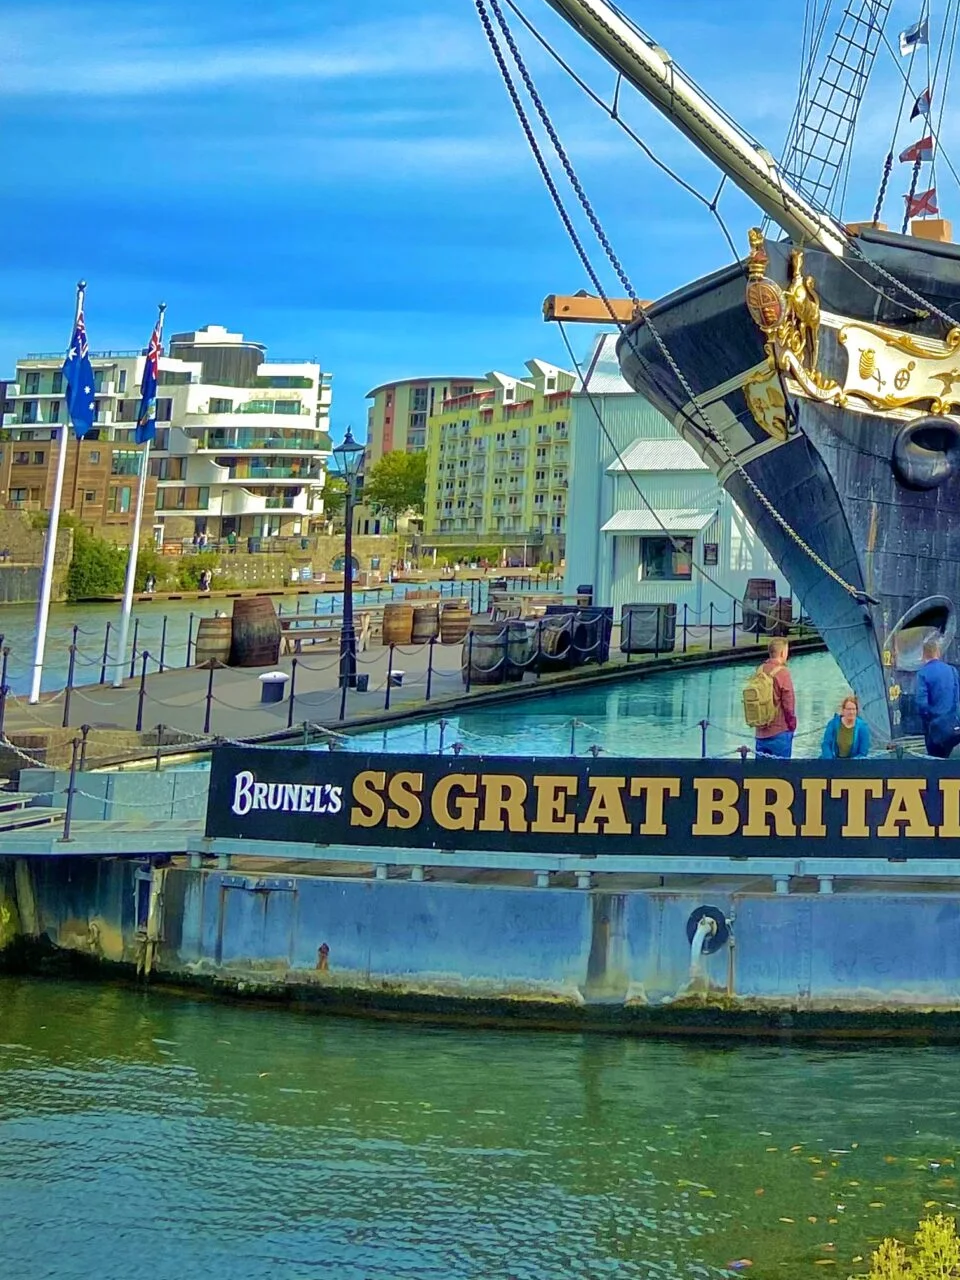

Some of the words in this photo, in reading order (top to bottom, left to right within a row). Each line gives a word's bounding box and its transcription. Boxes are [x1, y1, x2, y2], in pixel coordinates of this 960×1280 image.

[231, 770, 343, 815] BRUNEL'S
[350, 771, 424, 829] SS
[431, 773, 680, 835] GREAT
